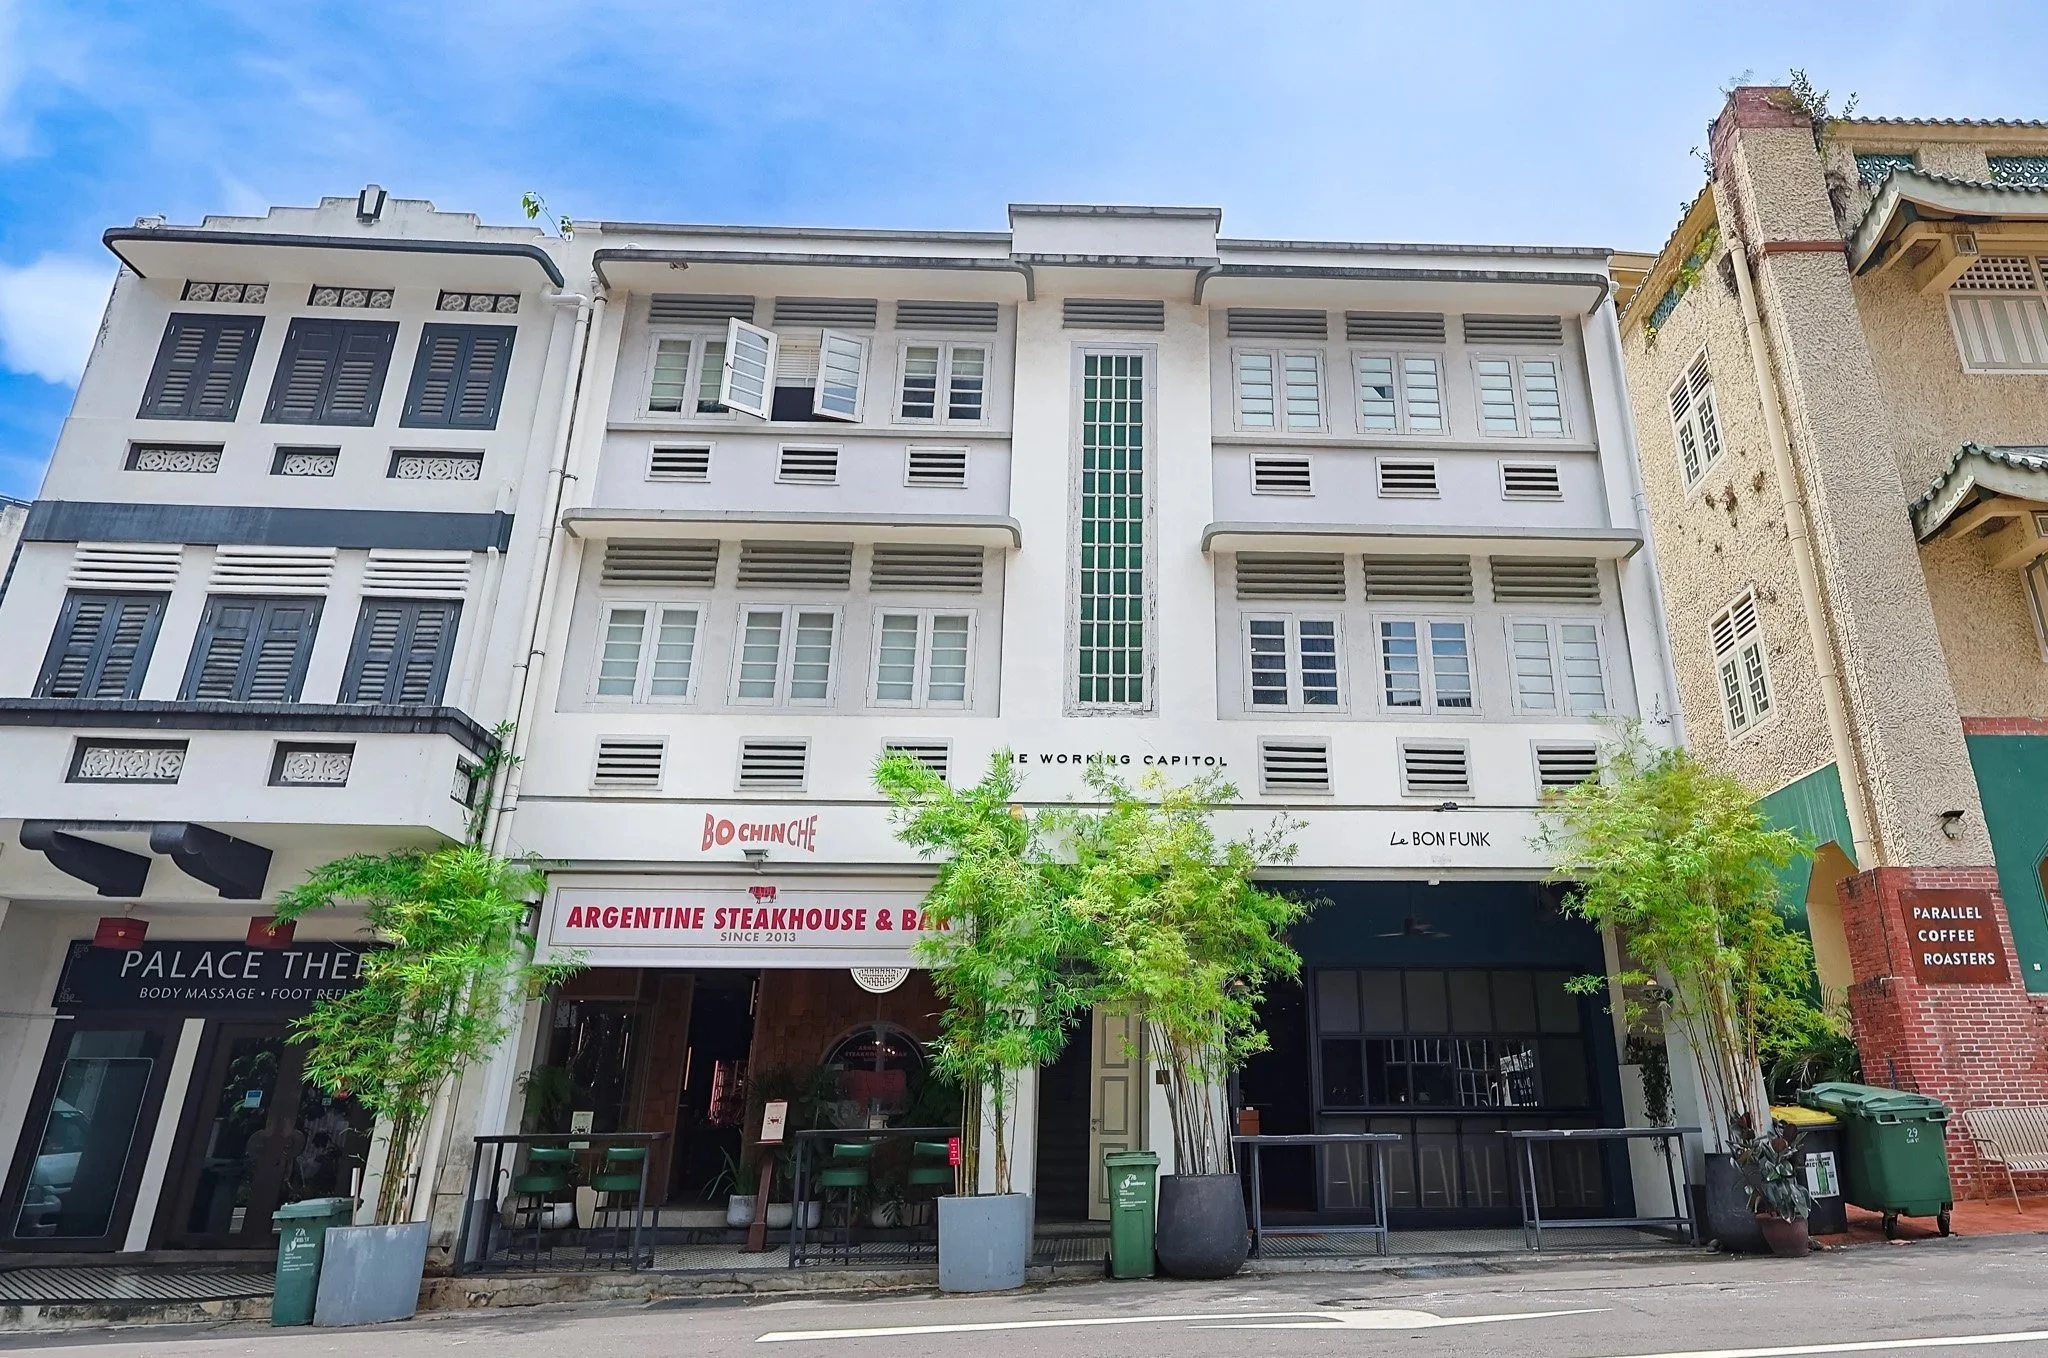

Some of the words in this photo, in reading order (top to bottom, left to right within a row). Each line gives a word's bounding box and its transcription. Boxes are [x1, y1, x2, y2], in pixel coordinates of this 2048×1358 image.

[1040, 753, 1131, 765] WORKING
[1143, 755, 1228, 766] CAPITOL
[1390, 831, 1409, 846] Le
[1412, 831, 1446, 846] BON
[1449, 831, 1491, 847] FUNK
[566, 906, 706, 930] ARGENTINE
[713, 907, 867, 931] STEAKHOUSE
[875, 908, 893, 931] &
[1913, 906, 1983, 920] PARALLEL
[720, 932, 760, 943] SINCE
[765, 932, 797, 943] 2013
[1918, 929, 1976, 942] COFFEE
[120, 950, 263, 979] PALACE
[1923, 952, 1996, 966] ROASTERS
[140, 987, 183, 1000] BODY
[185, 987, 255, 1000] MASSAGE
[271, 988, 313, 1001] FOOT
[1906, 1127, 1918, 1138] 29
